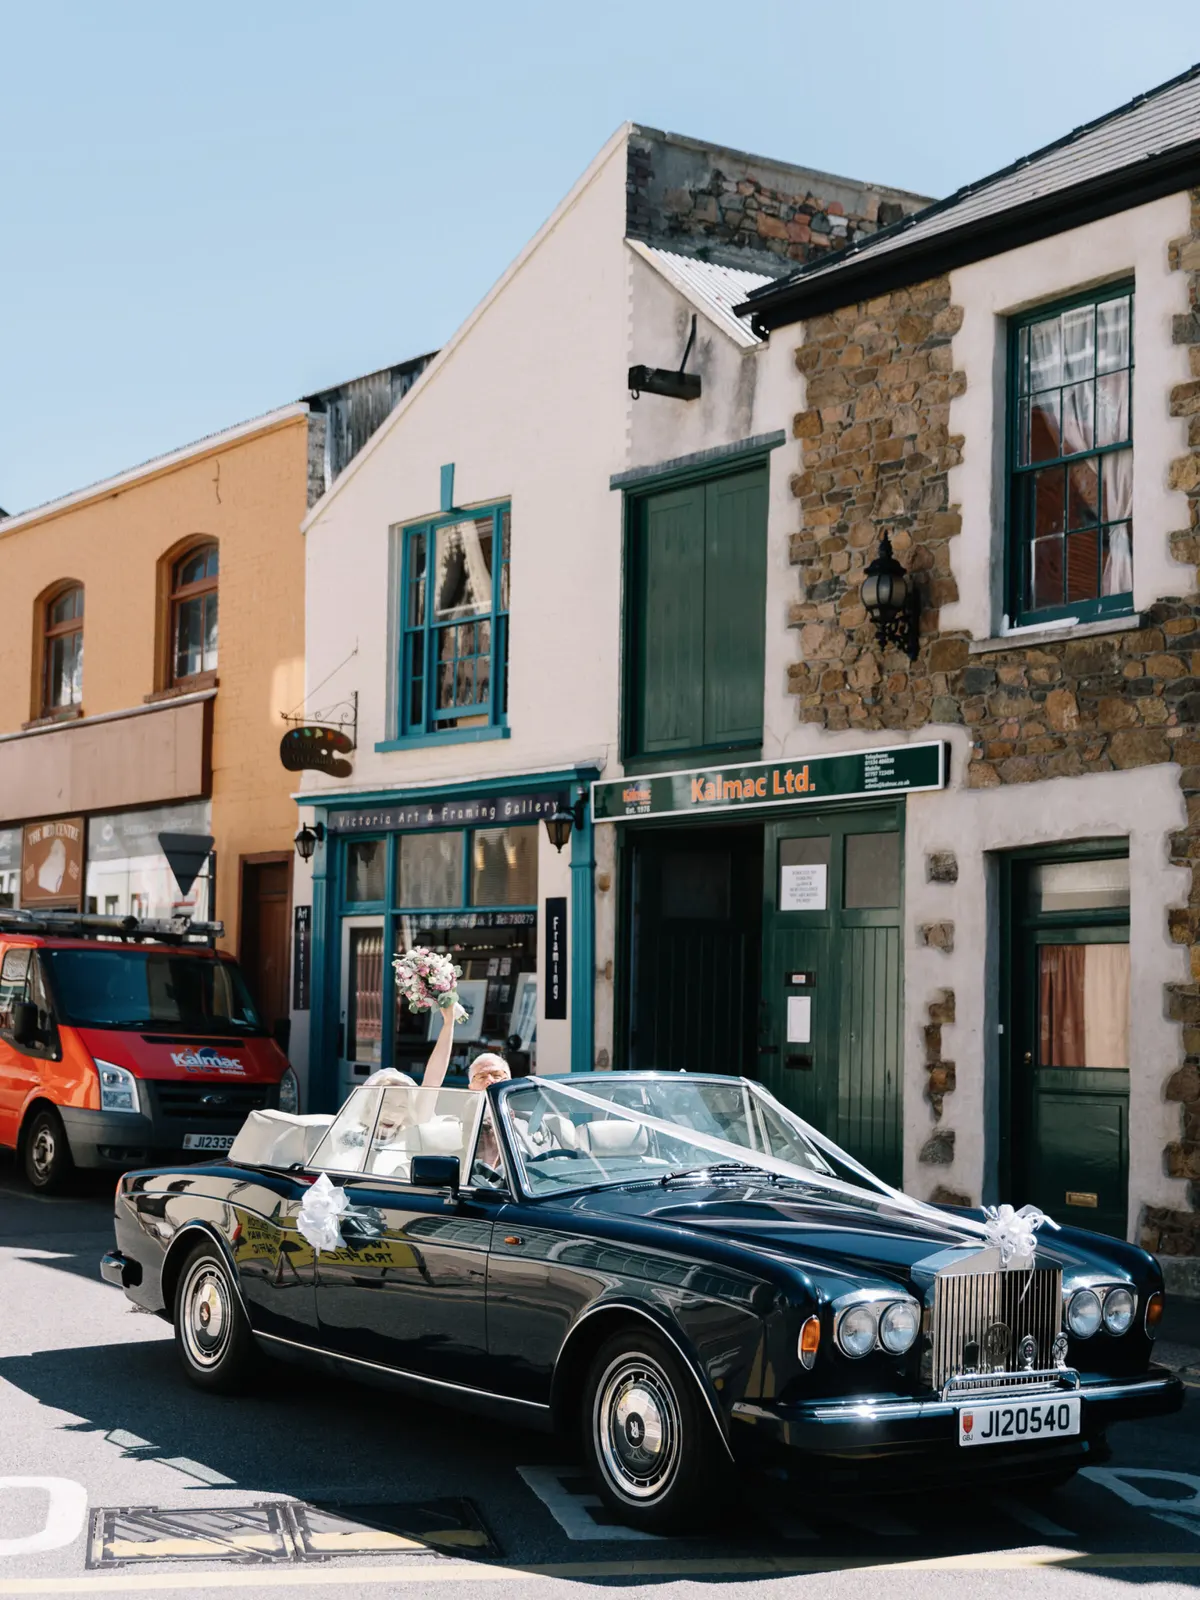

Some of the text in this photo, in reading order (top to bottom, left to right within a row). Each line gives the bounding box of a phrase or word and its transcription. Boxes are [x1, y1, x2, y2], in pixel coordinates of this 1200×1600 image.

[691, 765, 816, 803] Kalmac Ltd.
[338, 800, 559, 828] Victoria Art & Framing Gallery
[28, 828, 42, 846] THE
[297, 907, 308, 919] Art
[552, 916, 560, 1000] Framing
[170, 1052, 244, 1070] Kalmac
[980, 1403, 1070, 1438] J120540
[962, 1434, 974, 1442] GBJ
